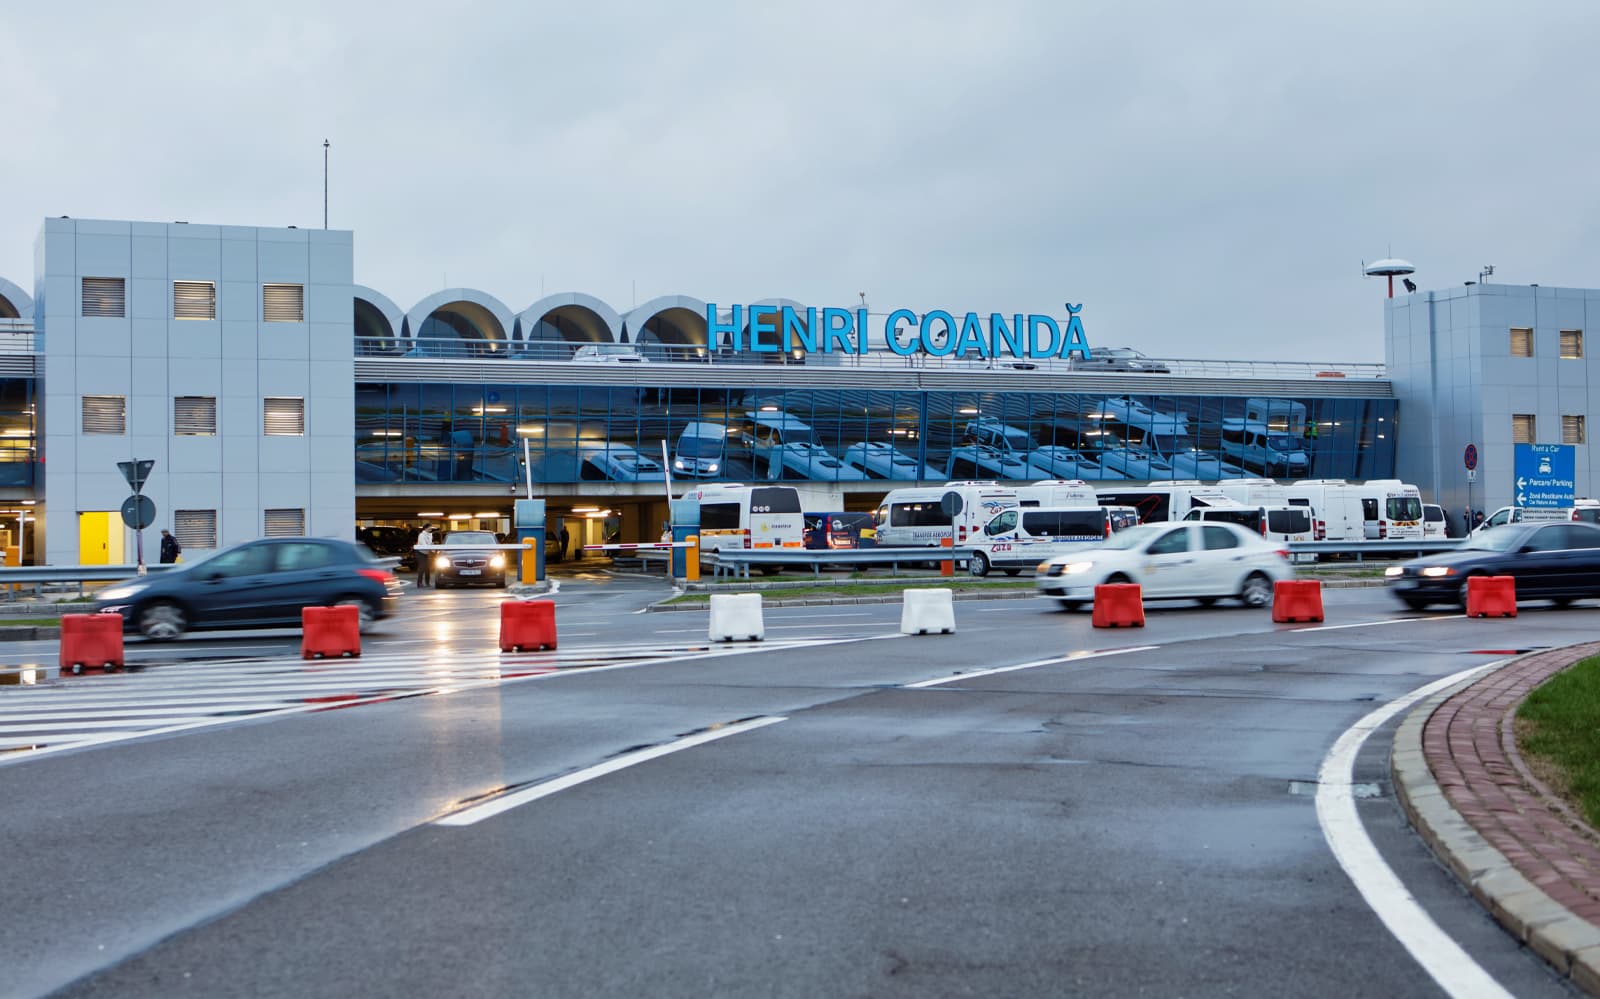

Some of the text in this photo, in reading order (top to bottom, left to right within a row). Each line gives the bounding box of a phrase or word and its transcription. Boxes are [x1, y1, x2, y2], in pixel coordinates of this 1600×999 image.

[706, 302, 1092, 360] HENRI COANDĂ
[1531, 445, 1545, 453] Rent
[1549, 445, 1560, 453] Car
[1552, 479, 1573, 489] Parking
